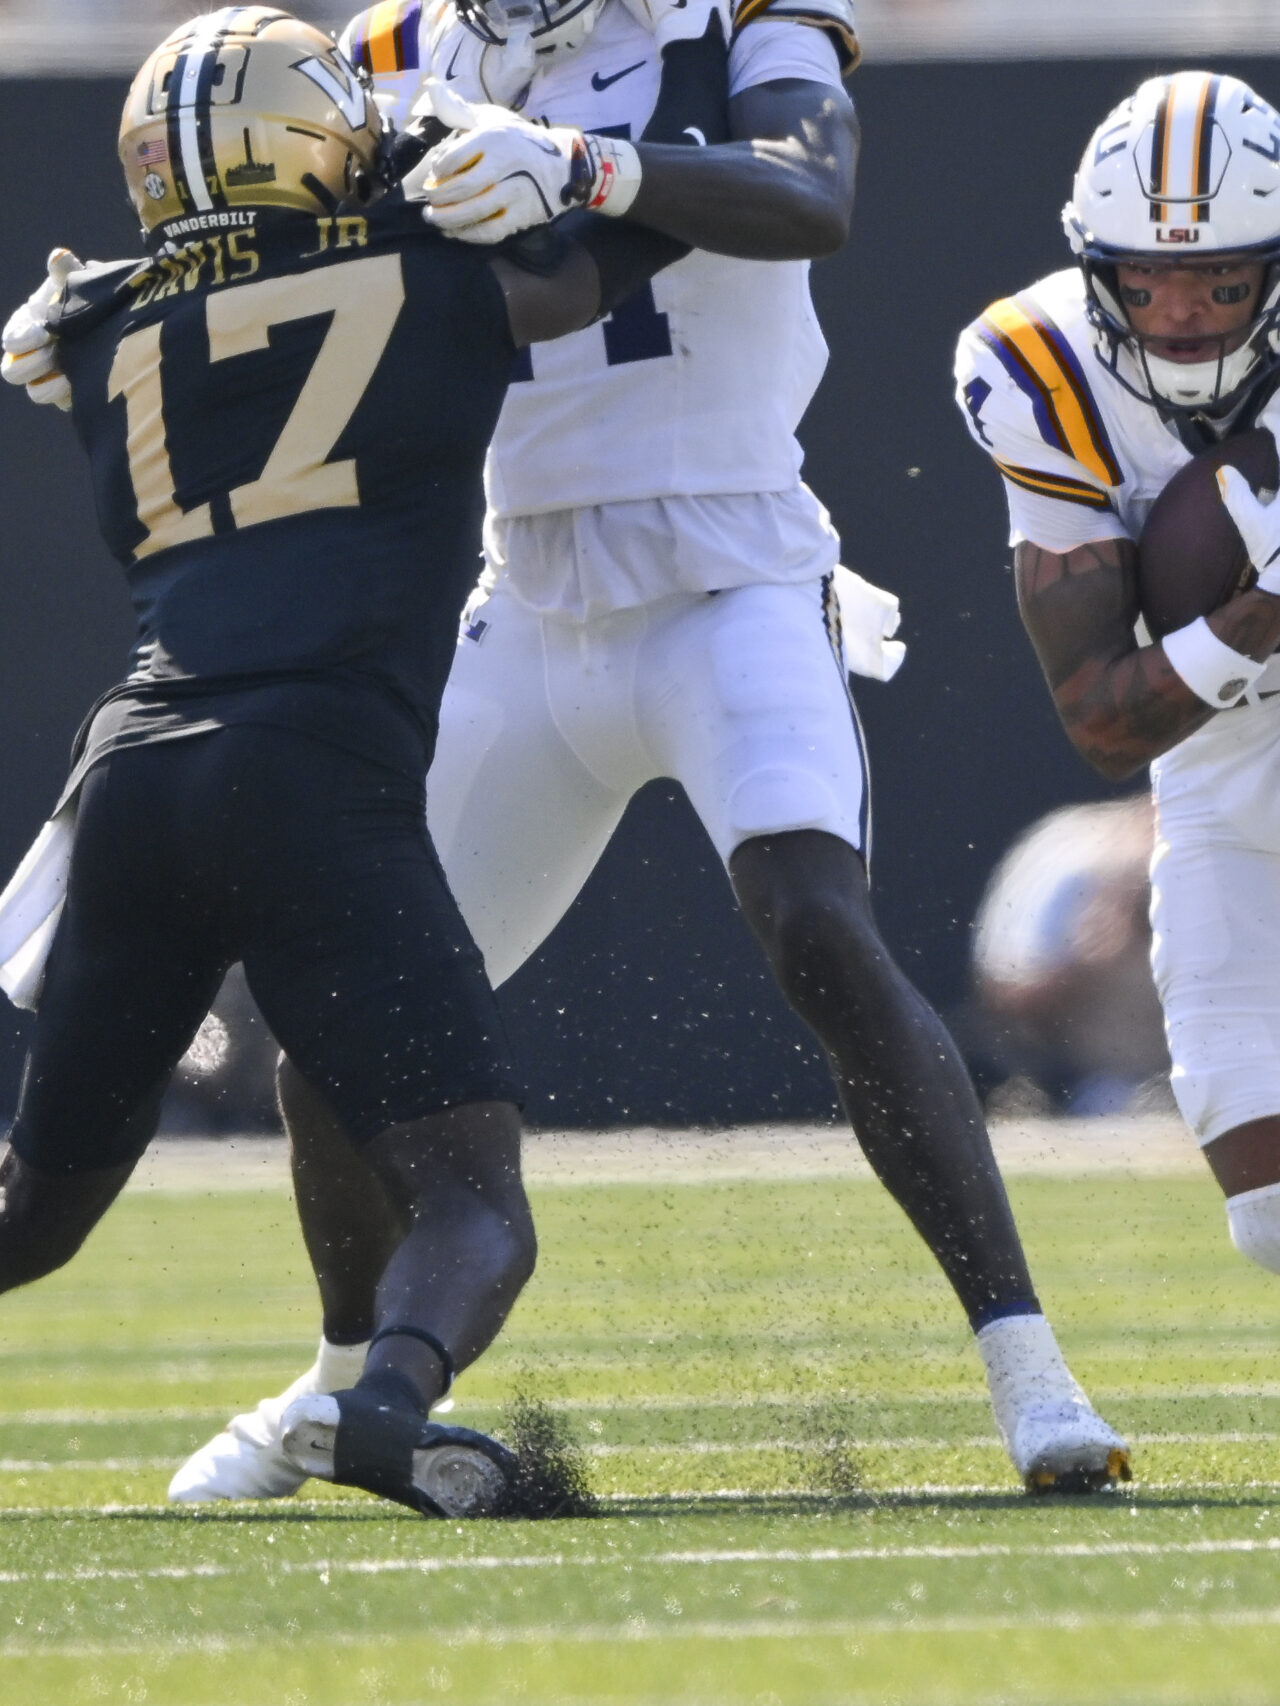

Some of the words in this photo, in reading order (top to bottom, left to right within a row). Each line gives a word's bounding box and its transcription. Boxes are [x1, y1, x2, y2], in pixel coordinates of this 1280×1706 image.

[288, 46, 367, 132] V
[163, 211, 257, 238] VANDERBILT
[299, 216, 369, 259] JR
[1155, 228, 1200, 244] LSU
[107, 252, 406, 561] 17
